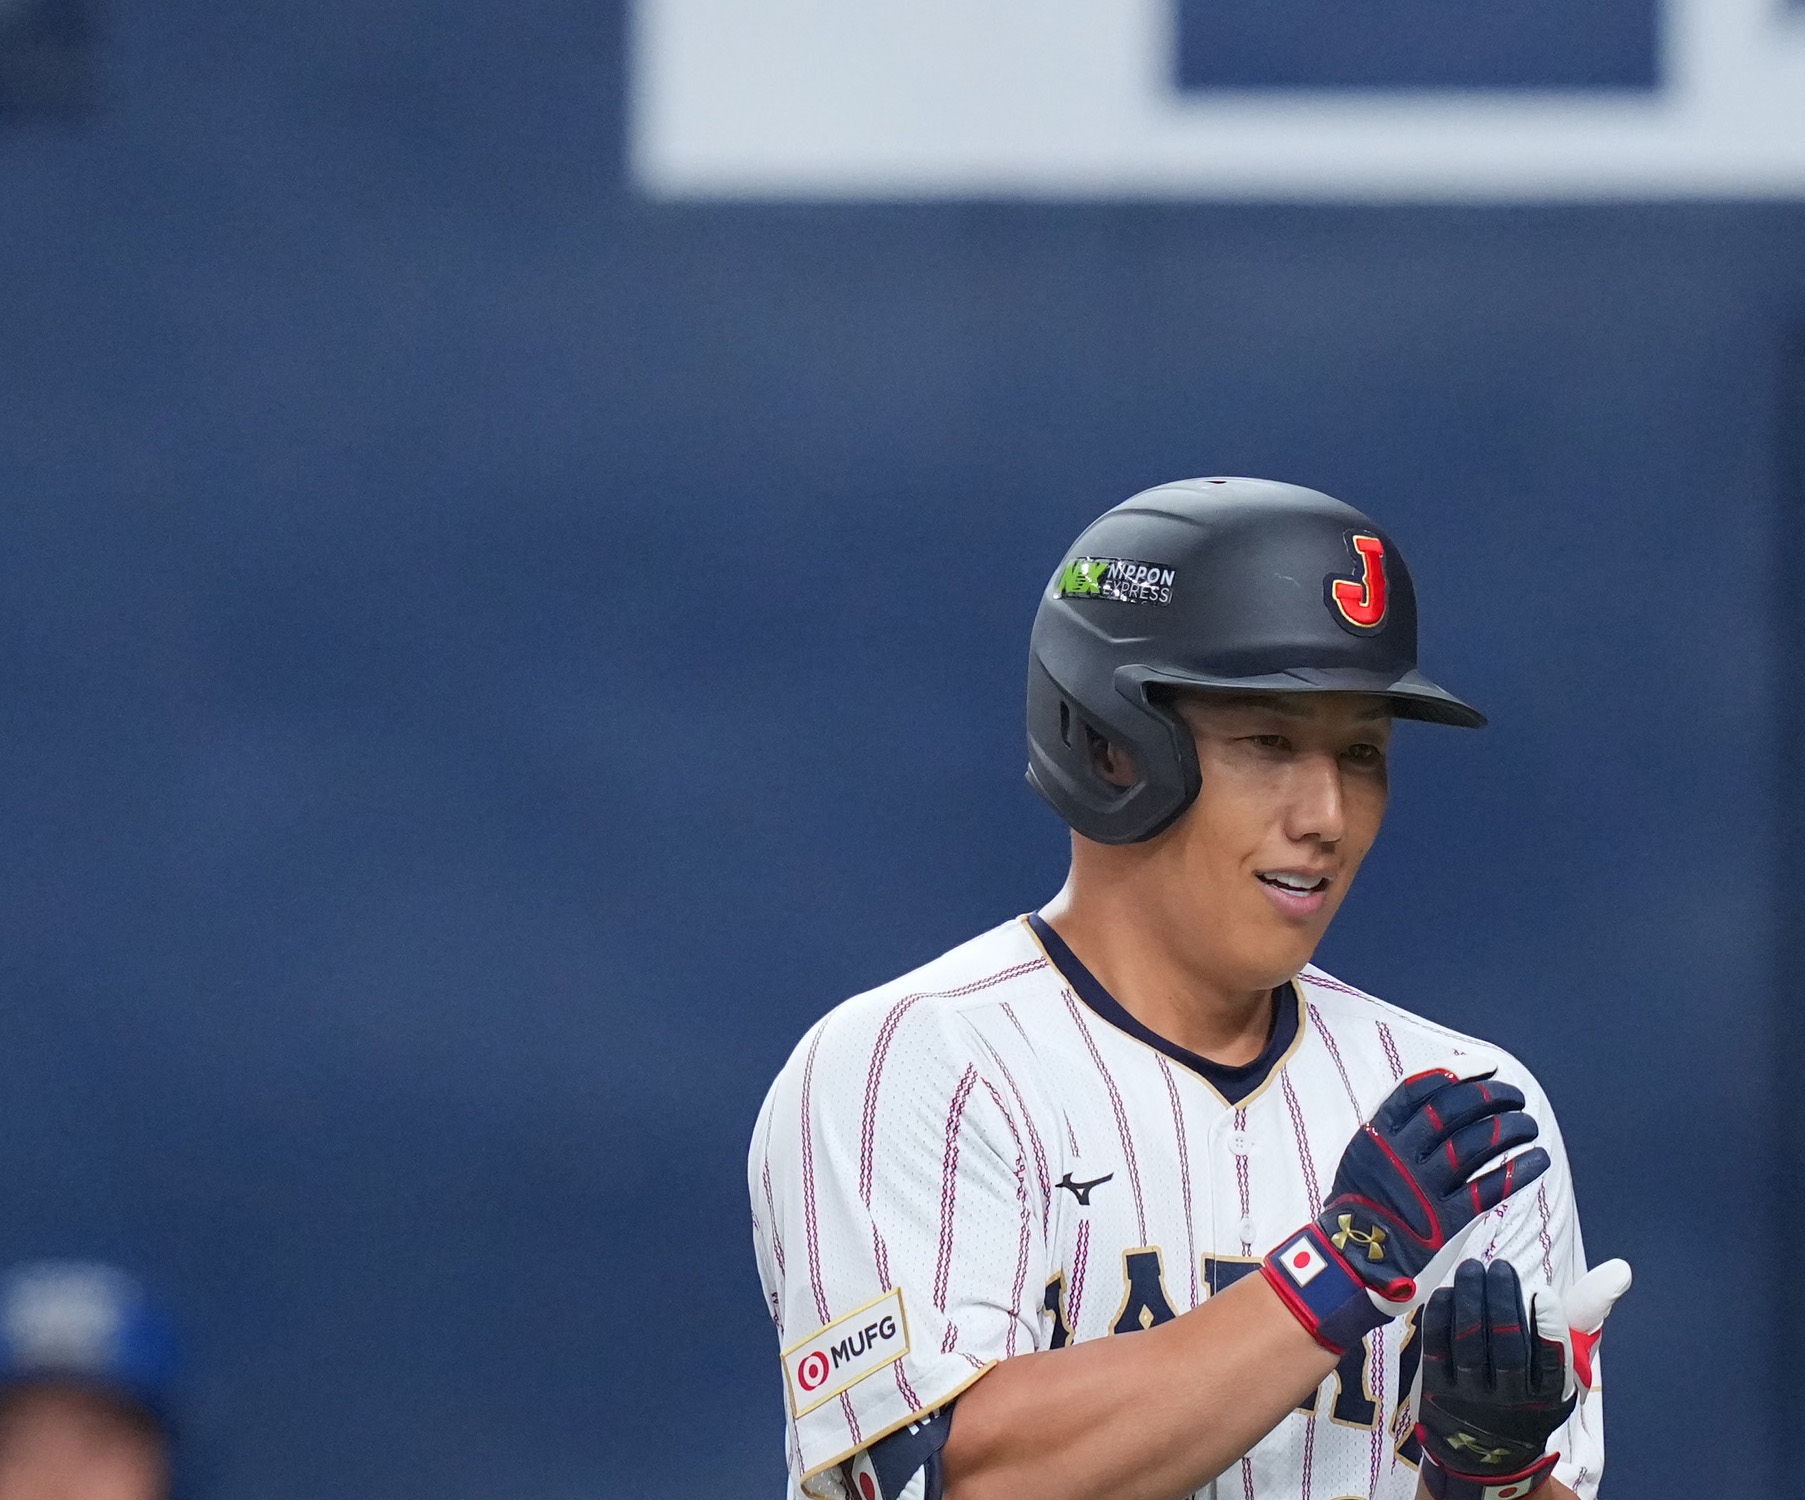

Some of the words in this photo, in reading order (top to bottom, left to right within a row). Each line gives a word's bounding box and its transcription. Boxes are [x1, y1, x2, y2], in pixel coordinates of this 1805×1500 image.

[1103, 579, 1171, 604] EXPRESS
[1107, 561, 1175, 587] NIPPON
[1333, 535, 1387, 629] J
[830, 1315, 896, 1369] MUFG
